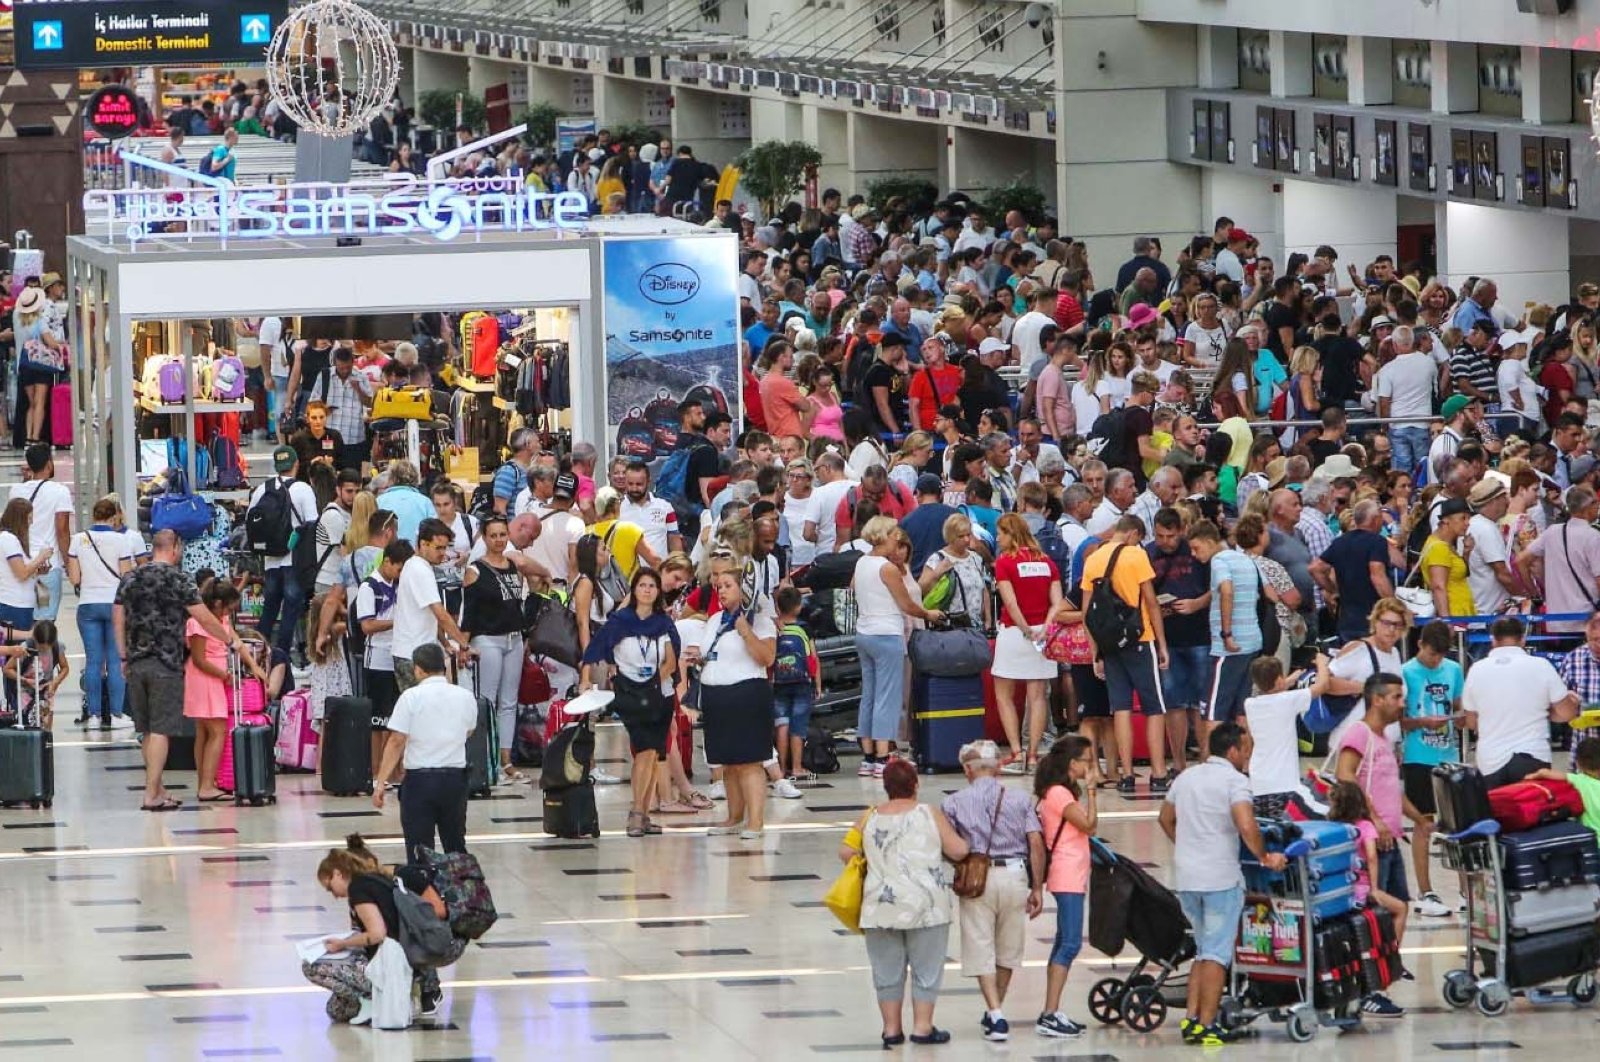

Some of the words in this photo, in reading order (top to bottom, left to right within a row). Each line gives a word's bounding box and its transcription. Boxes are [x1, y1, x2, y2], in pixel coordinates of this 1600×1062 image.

[94, 12, 106, 34] İç
[109, 14, 148, 30] Hatlar
[151, 12, 209, 28] Terminali
[96, 36, 153, 52] Domestic
[155, 33, 209, 49] Terminal
[645, 274, 697, 295] Disney
[665, 310, 676, 321] by
[630, 328, 712, 342] Samsonite
